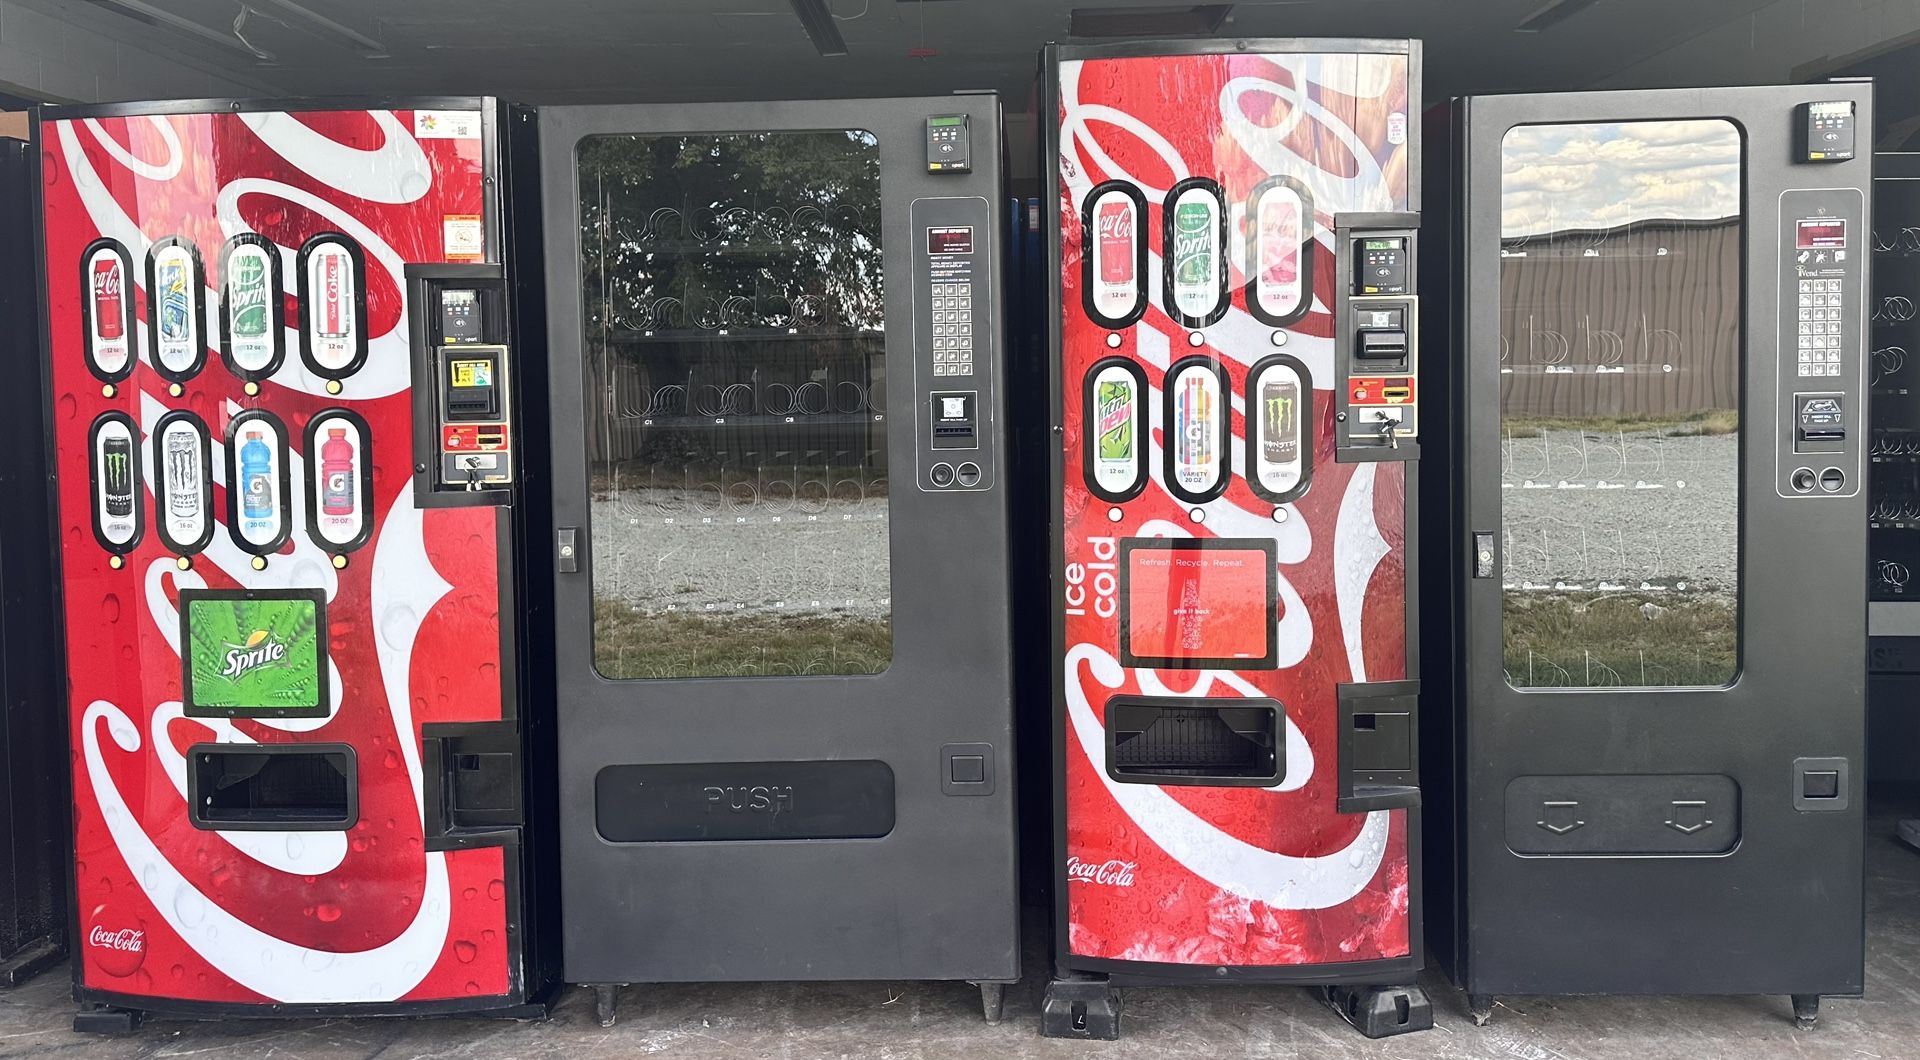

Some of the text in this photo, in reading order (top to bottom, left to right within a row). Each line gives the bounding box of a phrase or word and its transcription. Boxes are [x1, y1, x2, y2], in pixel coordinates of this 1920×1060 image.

[327, 266, 338, 302] Coke
[1066, 563, 1086, 616] Ice
[1087, 537, 1117, 618] cold
[223, 639, 284, 678] Sprite
[703, 785, 793, 812] PUSH
[90, 925, 145, 952] Coca-Cola
